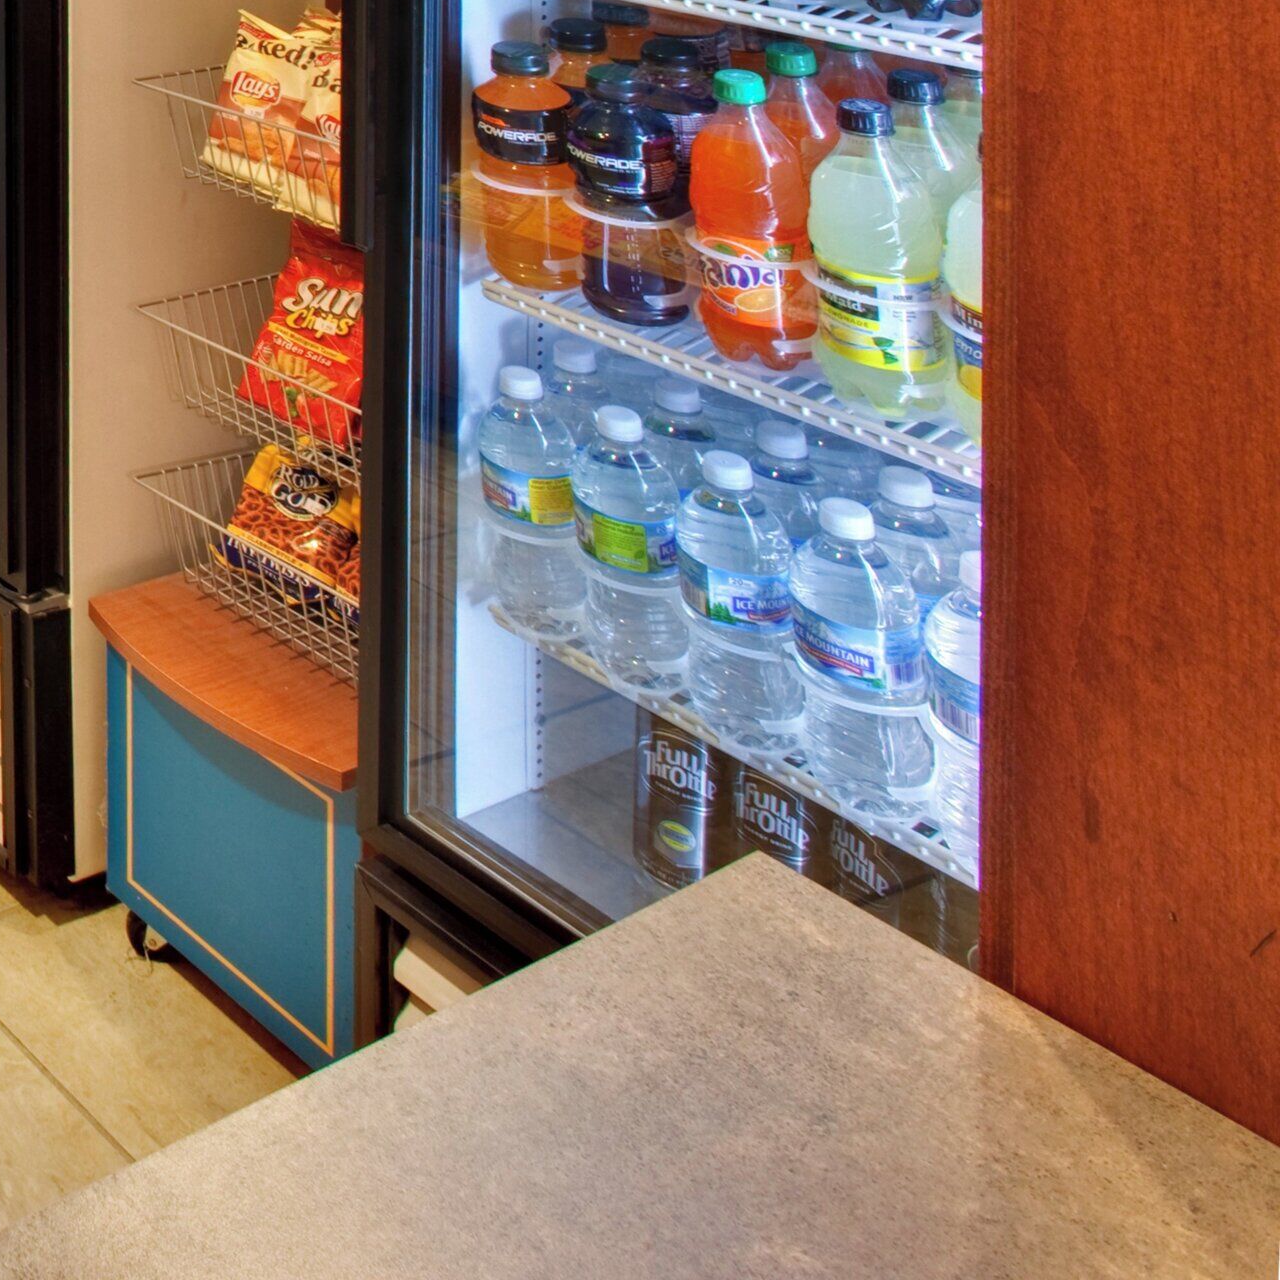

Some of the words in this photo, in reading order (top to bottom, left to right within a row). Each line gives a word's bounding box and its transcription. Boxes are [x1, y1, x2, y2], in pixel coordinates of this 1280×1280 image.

[477, 120, 558, 143] POWERADE
[566, 143, 645, 171] POWERADE
[281, 278, 364, 319] Sun
[272, 333, 305, 355] Garden
[304, 350, 333, 368] Salsa
[279, 462, 319, 490] ROLD
[735, 599, 755, 611] ICE
[806, 633, 871, 669] MOUNTAIN
